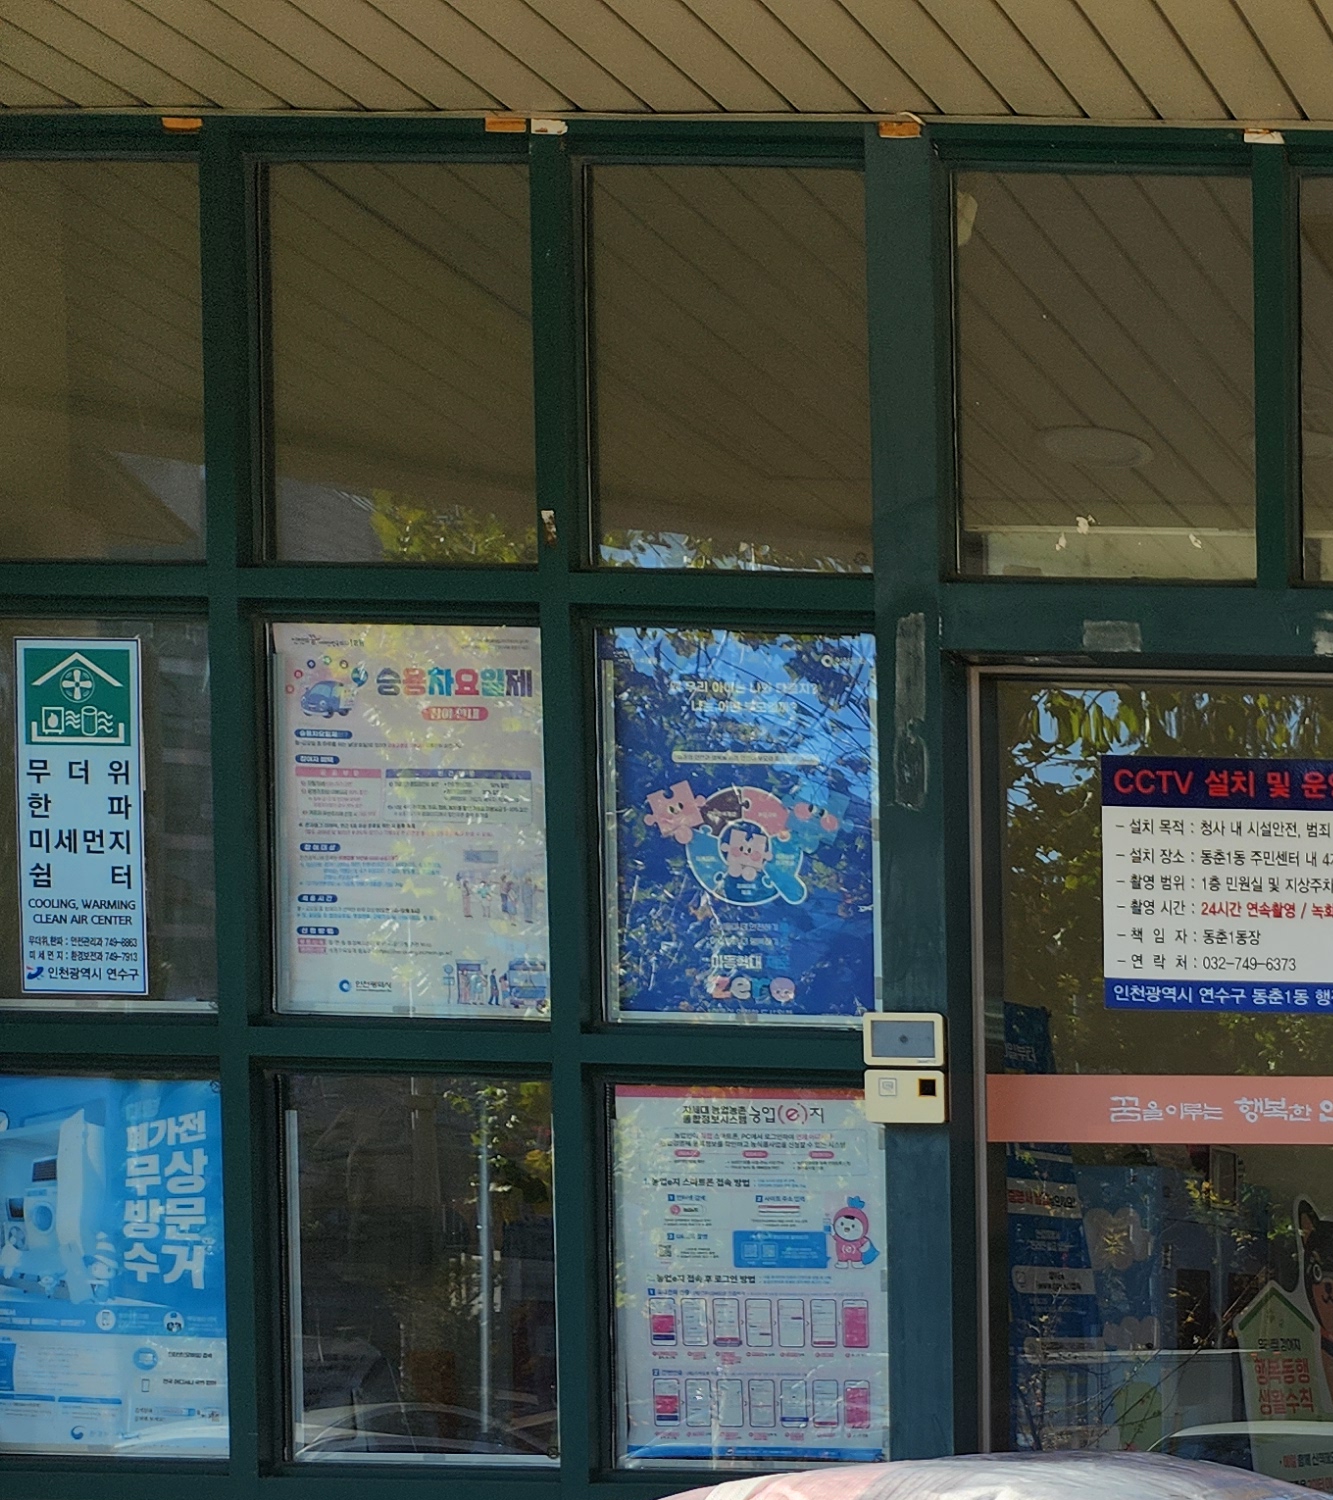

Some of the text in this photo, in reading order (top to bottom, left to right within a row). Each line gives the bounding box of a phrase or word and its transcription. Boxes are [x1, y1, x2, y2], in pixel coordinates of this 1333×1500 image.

[376, 667, 533, 697] 승용차요일제
[1113, 769, 1194, 797] CCTV
[1204, 770, 1256, 798] 설치
[1266, 772, 1291, 799] 및
[1129, 820, 1156, 836] 설치
[1159, 820, 1186, 837] 목적
[1200, 820, 1226, 837] 청사
[1230, 821, 1243, 838] 내
[1247, 821, 1300, 838] 시설안전,
[1306, 822, 1332, 839] 범죄
[29, 829, 132, 855] 미세먼지
[1129, 849, 1156, 865] 설치
[1159, 849, 1186, 866] 장소
[1200, 850, 1246, 867] 동춘1동
[1250, 850, 1300, 867] 주민센터
[1305, 851, 1319, 868] 내
[1129, 875, 1156, 892] 촬영
[1159, 875, 1186, 893] 범위
[1202, 876, 1222, 892] 1층
[1225, 876, 1264, 894] 민원실
[1268, 877, 1281, 895] 및
[82, 899, 136, 911] WARMING
[1129, 900, 1157, 918] 촬영
[1159, 901, 1186, 918] 시간
[1201, 901, 1242, 919] 24시간
[1246, 902, 1297, 920] 연속촬영
[33, 914, 133, 926] CLEAN AIR CENTER
[1202, 928, 1262, 947] 동춘1동장
[1202, 955, 1297, 972] 032-749-6373
[47, 966, 140, 981] 인천광역시 연수구
[1113, 984, 1194, 1004] 인천광역시
[1198, 986, 1247, 1006] 연수구
[1250, 987, 1309, 1007] 동춘1동
[1233, 1097, 1313, 1123] 행복한
